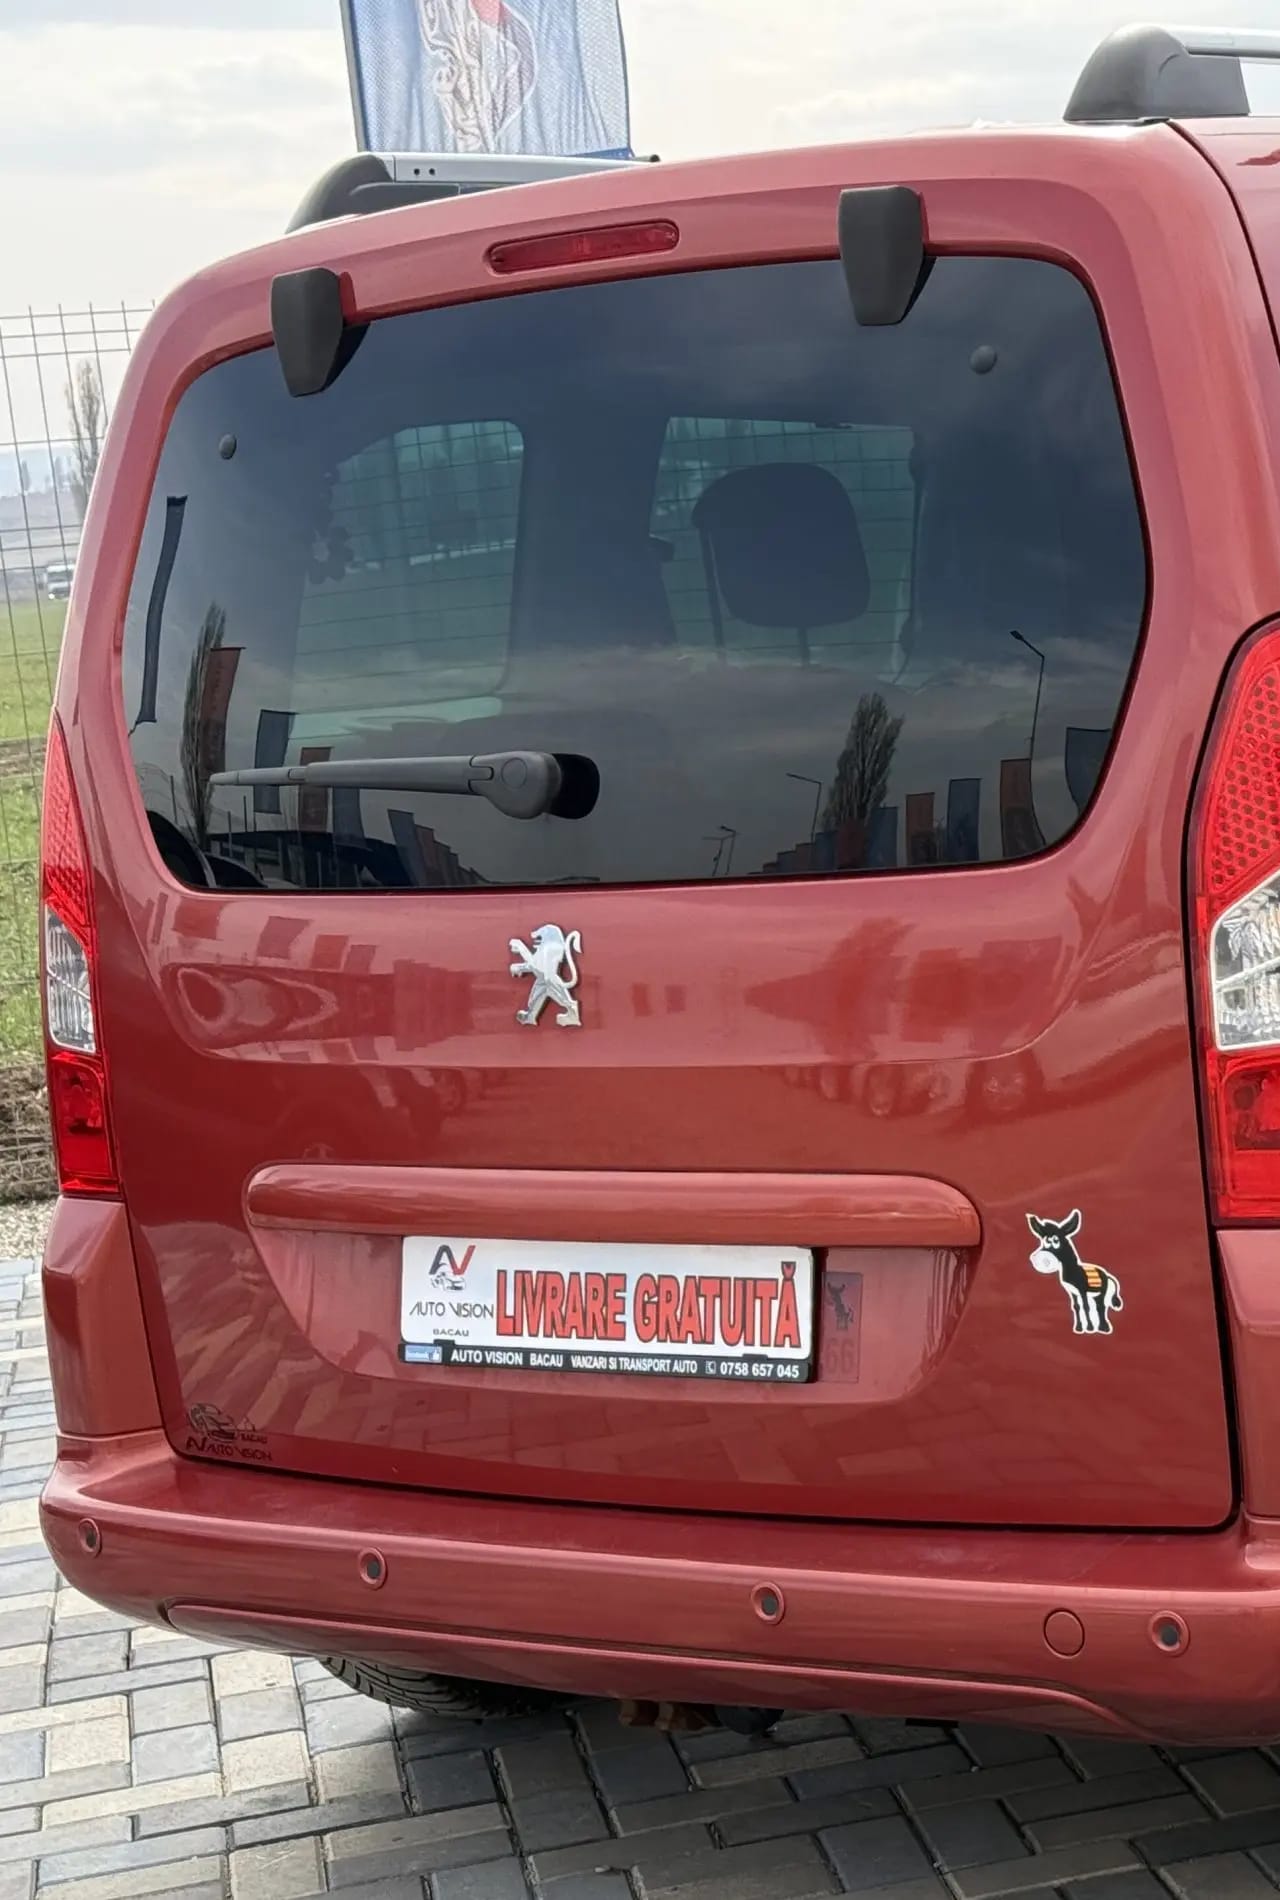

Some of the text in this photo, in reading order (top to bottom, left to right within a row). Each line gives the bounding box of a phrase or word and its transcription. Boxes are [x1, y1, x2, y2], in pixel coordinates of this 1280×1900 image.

[409, 1301, 495, 1319] AUTO VISION
[496, 1261, 801, 1349] LIVRARE GRATUITĂ
[433, 1328, 470, 1337] BACAU
[450, 1349, 800, 1379] AUTO VISION BACAU VANZARI SI TRANSPORT AUTO 0758 657 045
